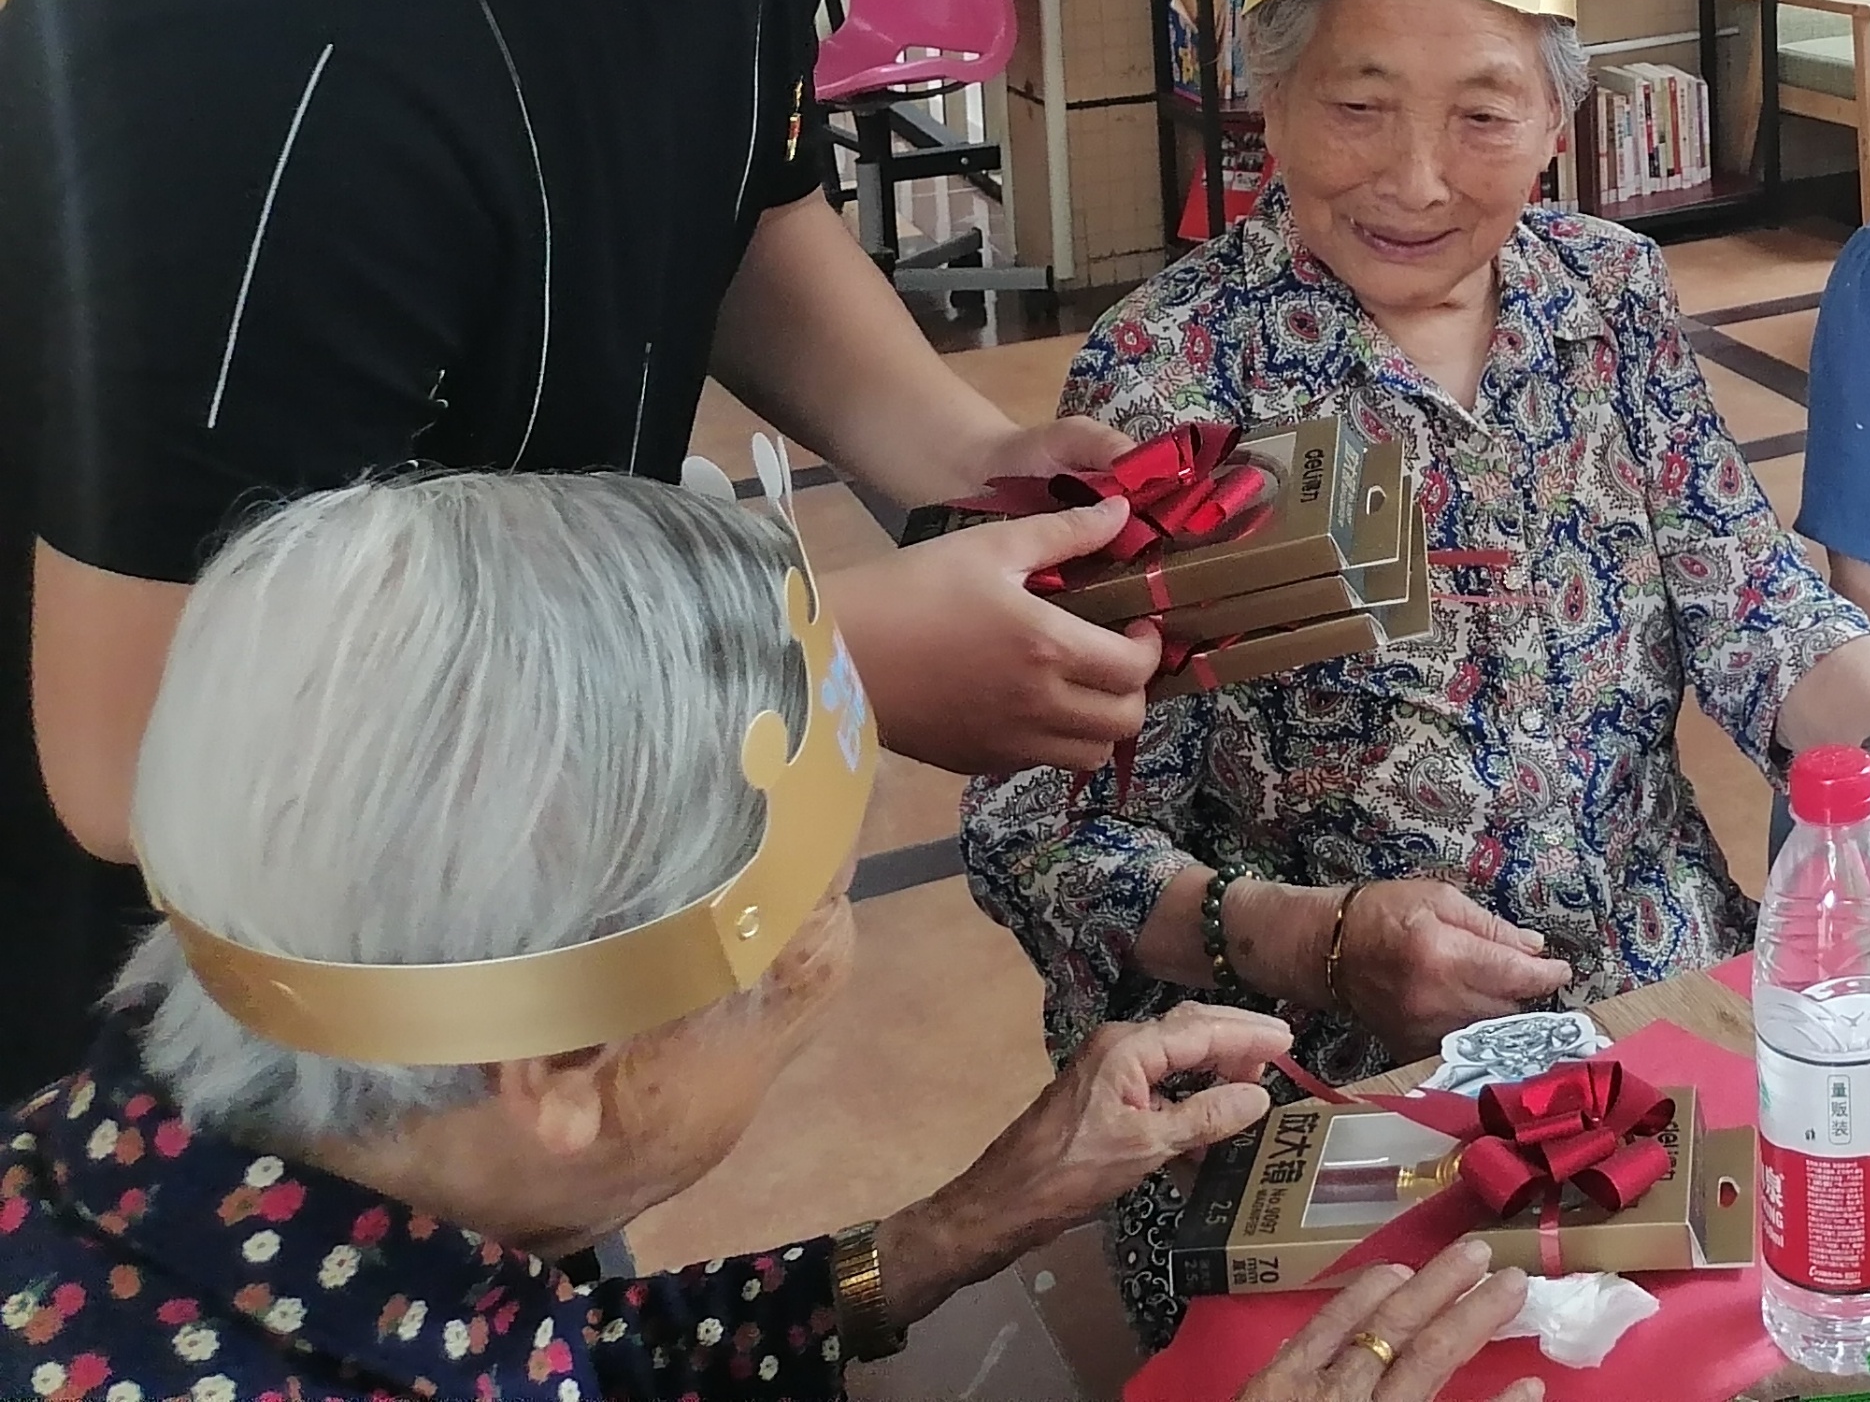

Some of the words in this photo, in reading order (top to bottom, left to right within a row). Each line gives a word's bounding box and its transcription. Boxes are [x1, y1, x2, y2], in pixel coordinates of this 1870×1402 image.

[1831, 1082, 1849, 1137] 量贩装
[1259, 1111, 1321, 1185] 放大镜
[1204, 1200, 1233, 1226] 2.5
[1258, 1256, 1280, 1285] 70
